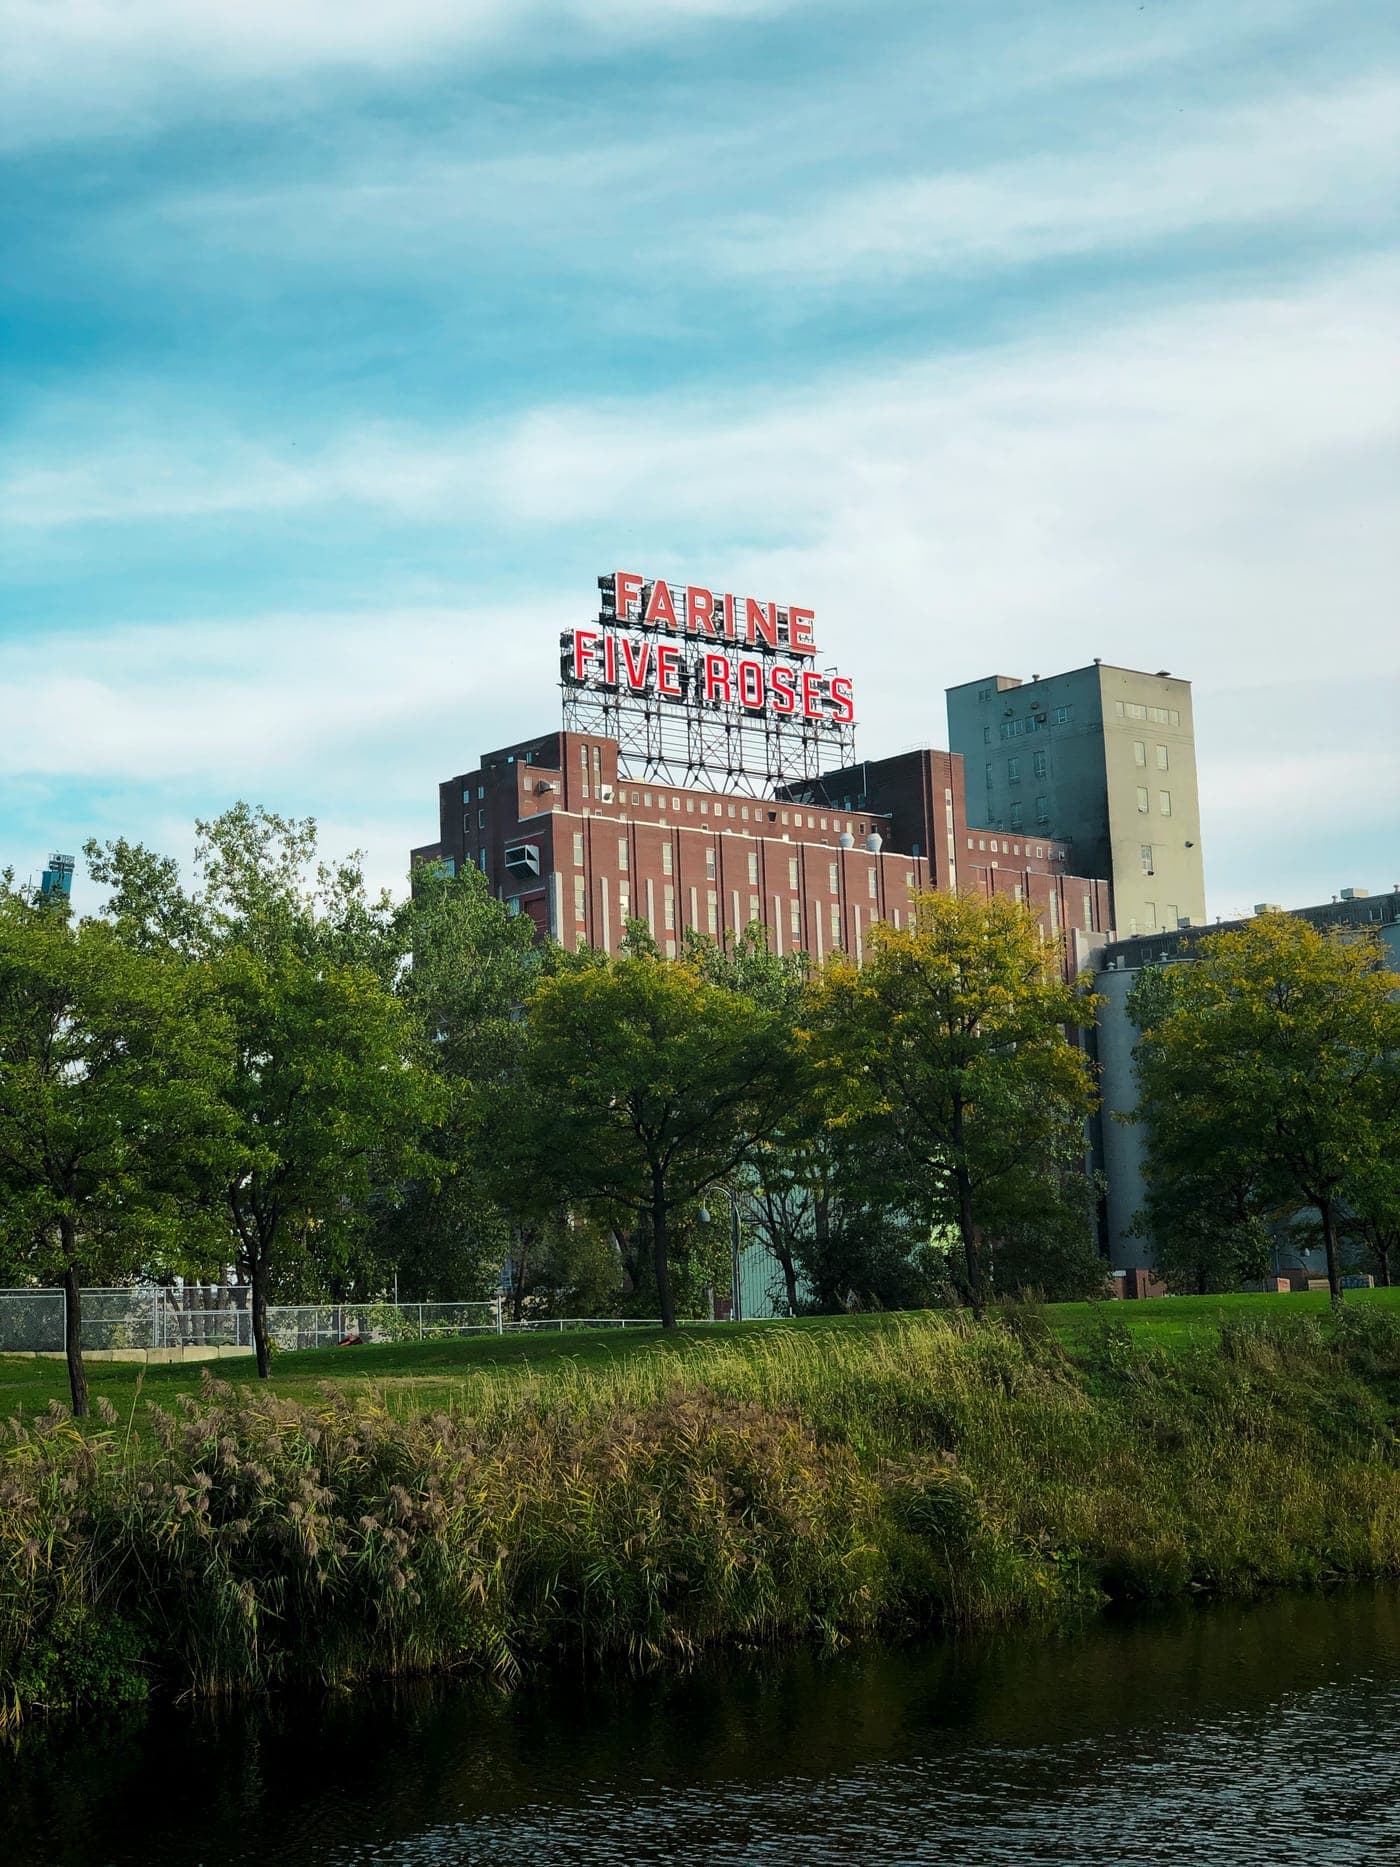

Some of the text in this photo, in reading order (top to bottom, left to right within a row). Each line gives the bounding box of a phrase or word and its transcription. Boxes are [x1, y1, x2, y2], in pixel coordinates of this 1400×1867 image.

[615, 571, 817, 653] FARINE
[574, 630, 855, 723] FIVE ROSES
